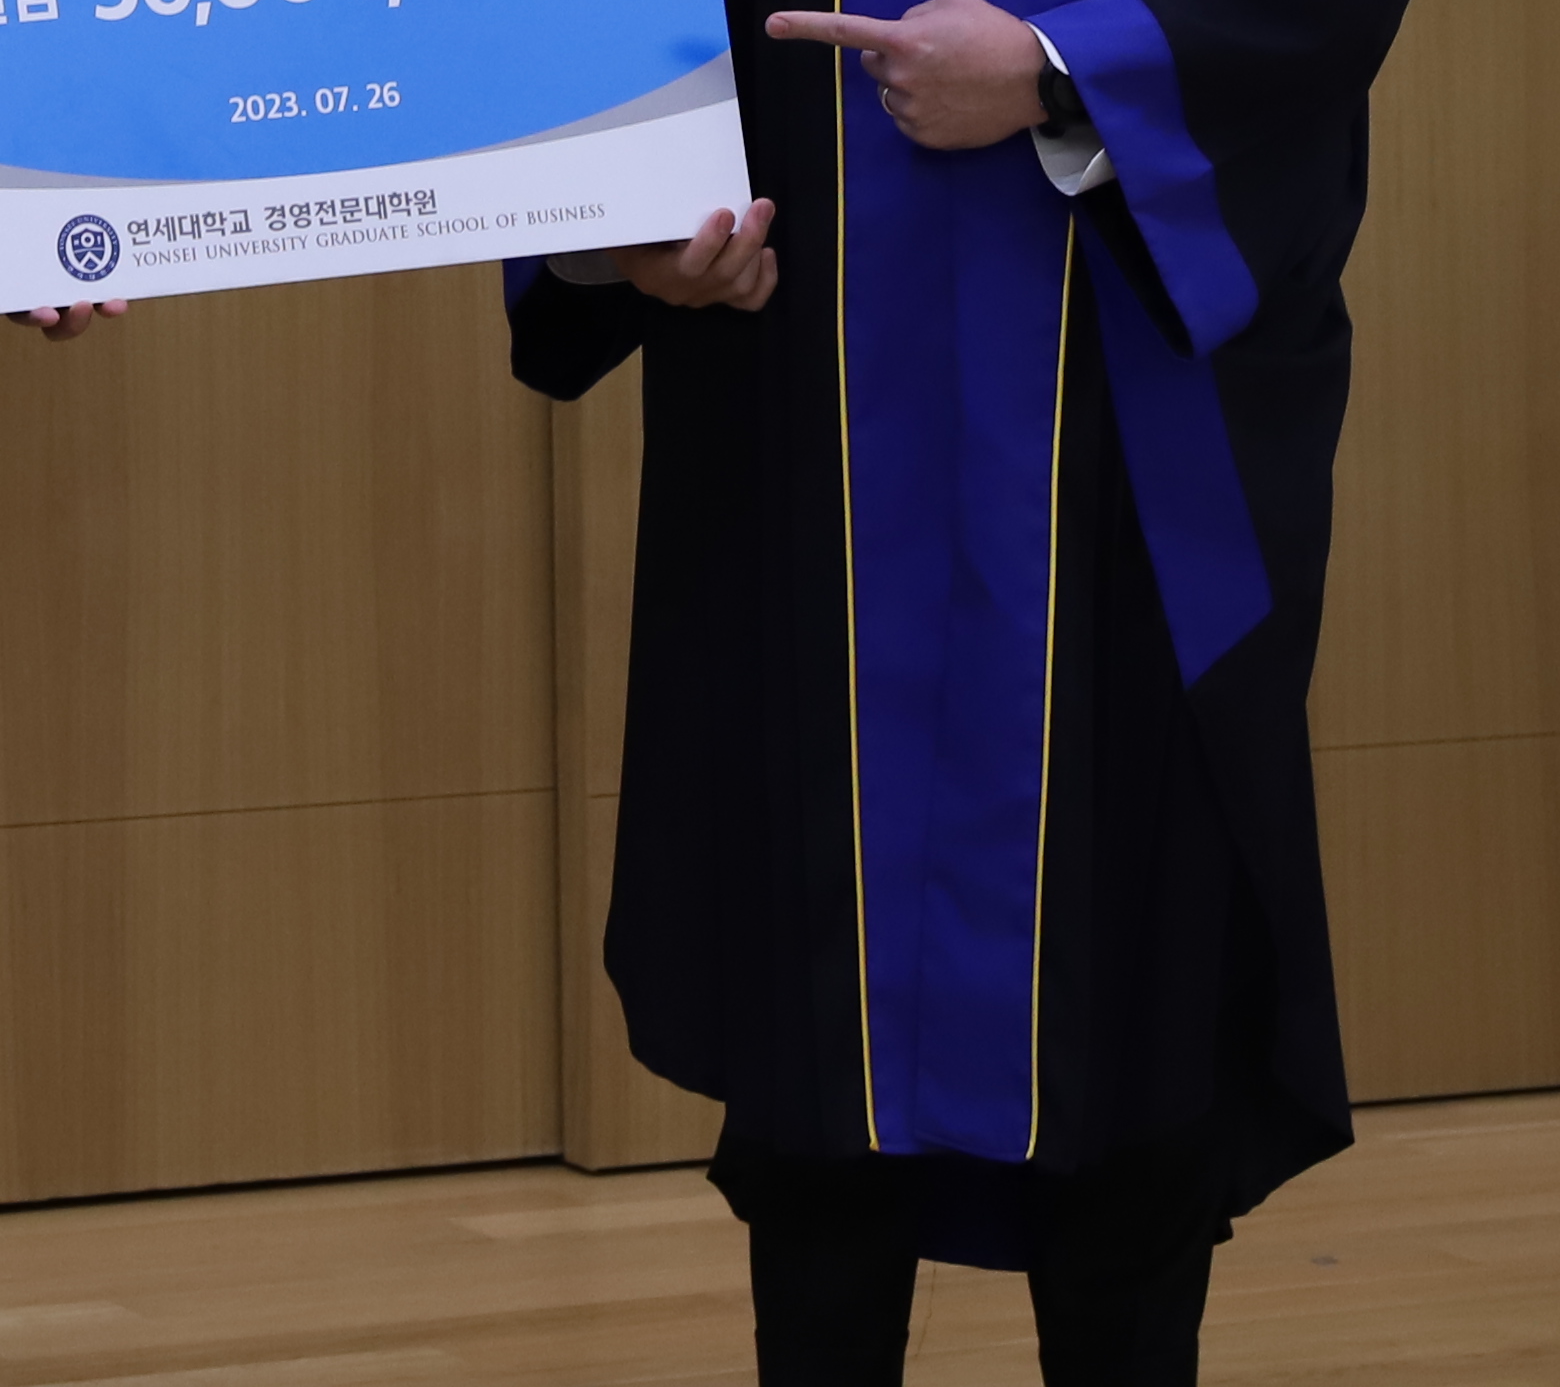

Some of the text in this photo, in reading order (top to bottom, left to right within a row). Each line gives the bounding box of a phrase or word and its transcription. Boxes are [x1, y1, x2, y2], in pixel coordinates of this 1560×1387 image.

[228, 81, 401, 123] 2023. 07. 26
[126, 189, 438, 246] 연세대학교 경영전문대학원
[132, 203, 605, 268] YONSEI UNIVERSITY GRADUATE SCHOOL OF BUSINESS
